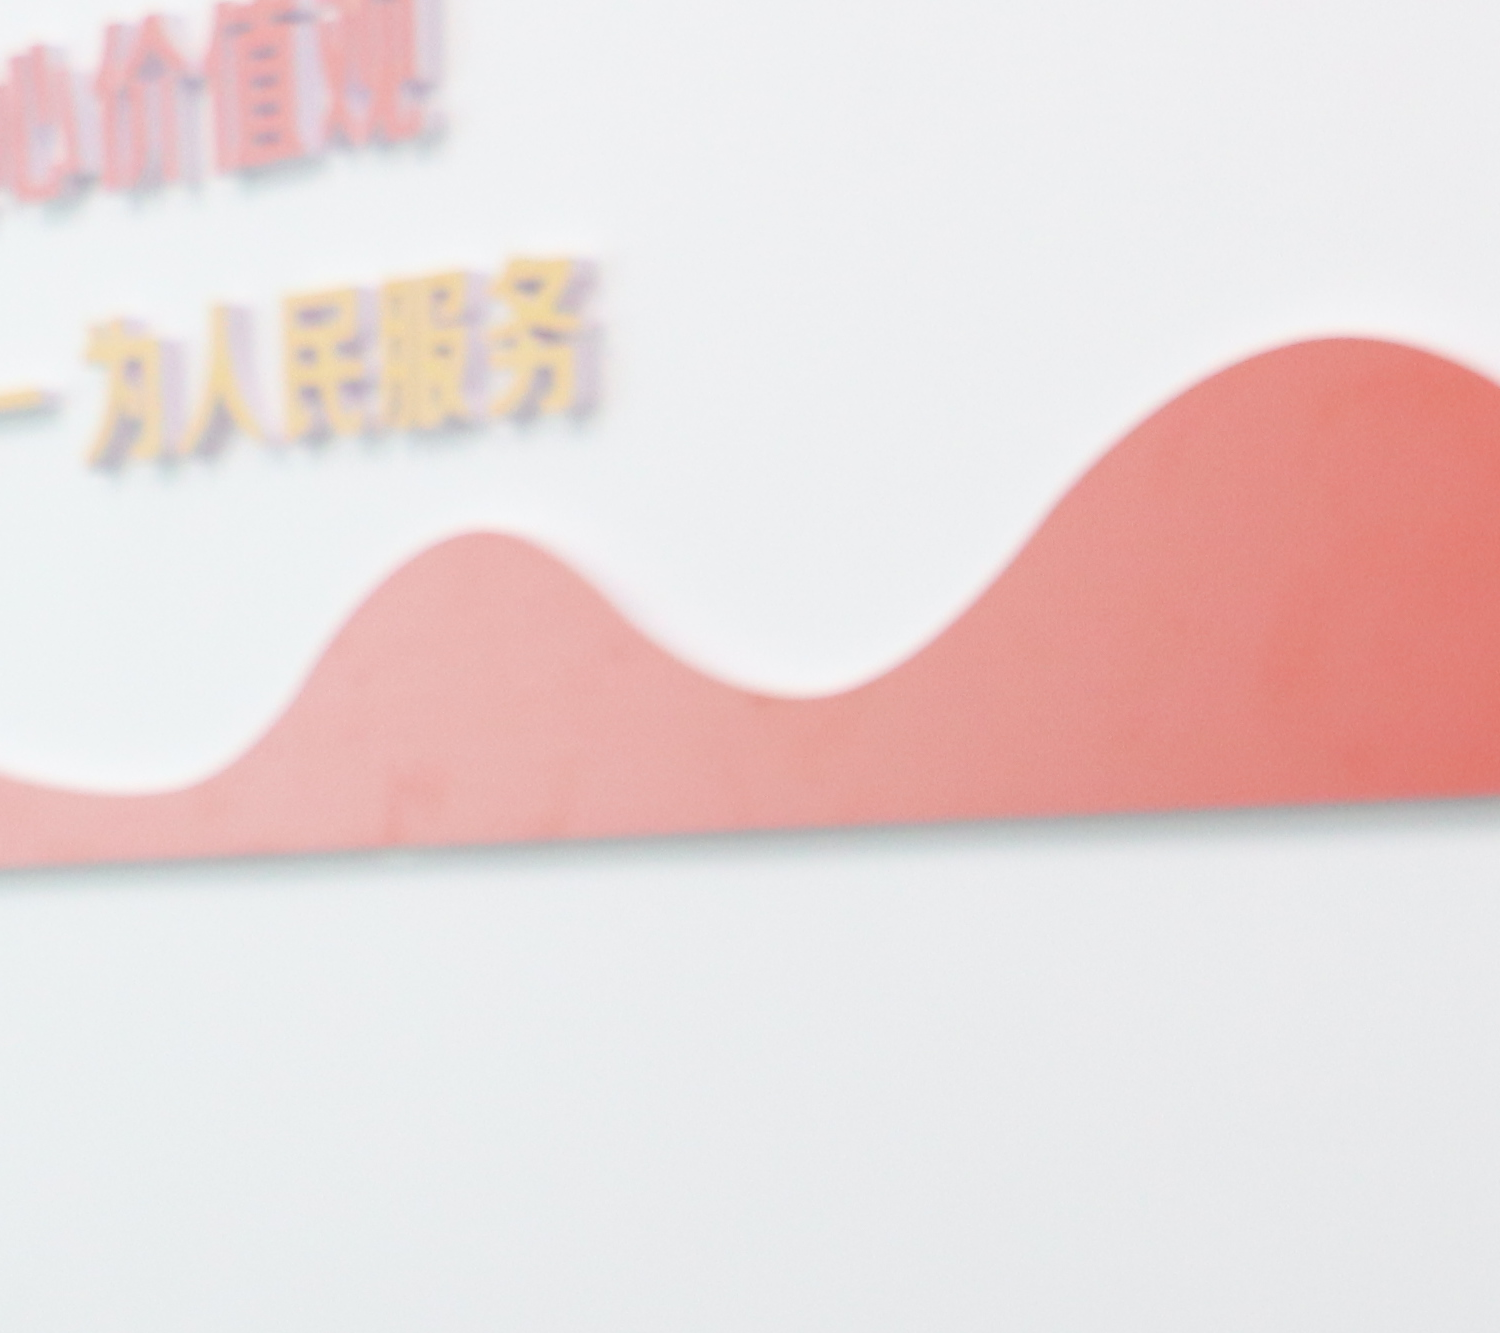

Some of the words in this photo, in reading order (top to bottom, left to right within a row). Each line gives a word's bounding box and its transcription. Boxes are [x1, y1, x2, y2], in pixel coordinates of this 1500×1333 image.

[84, 255, 594, 468] 为人民服务
